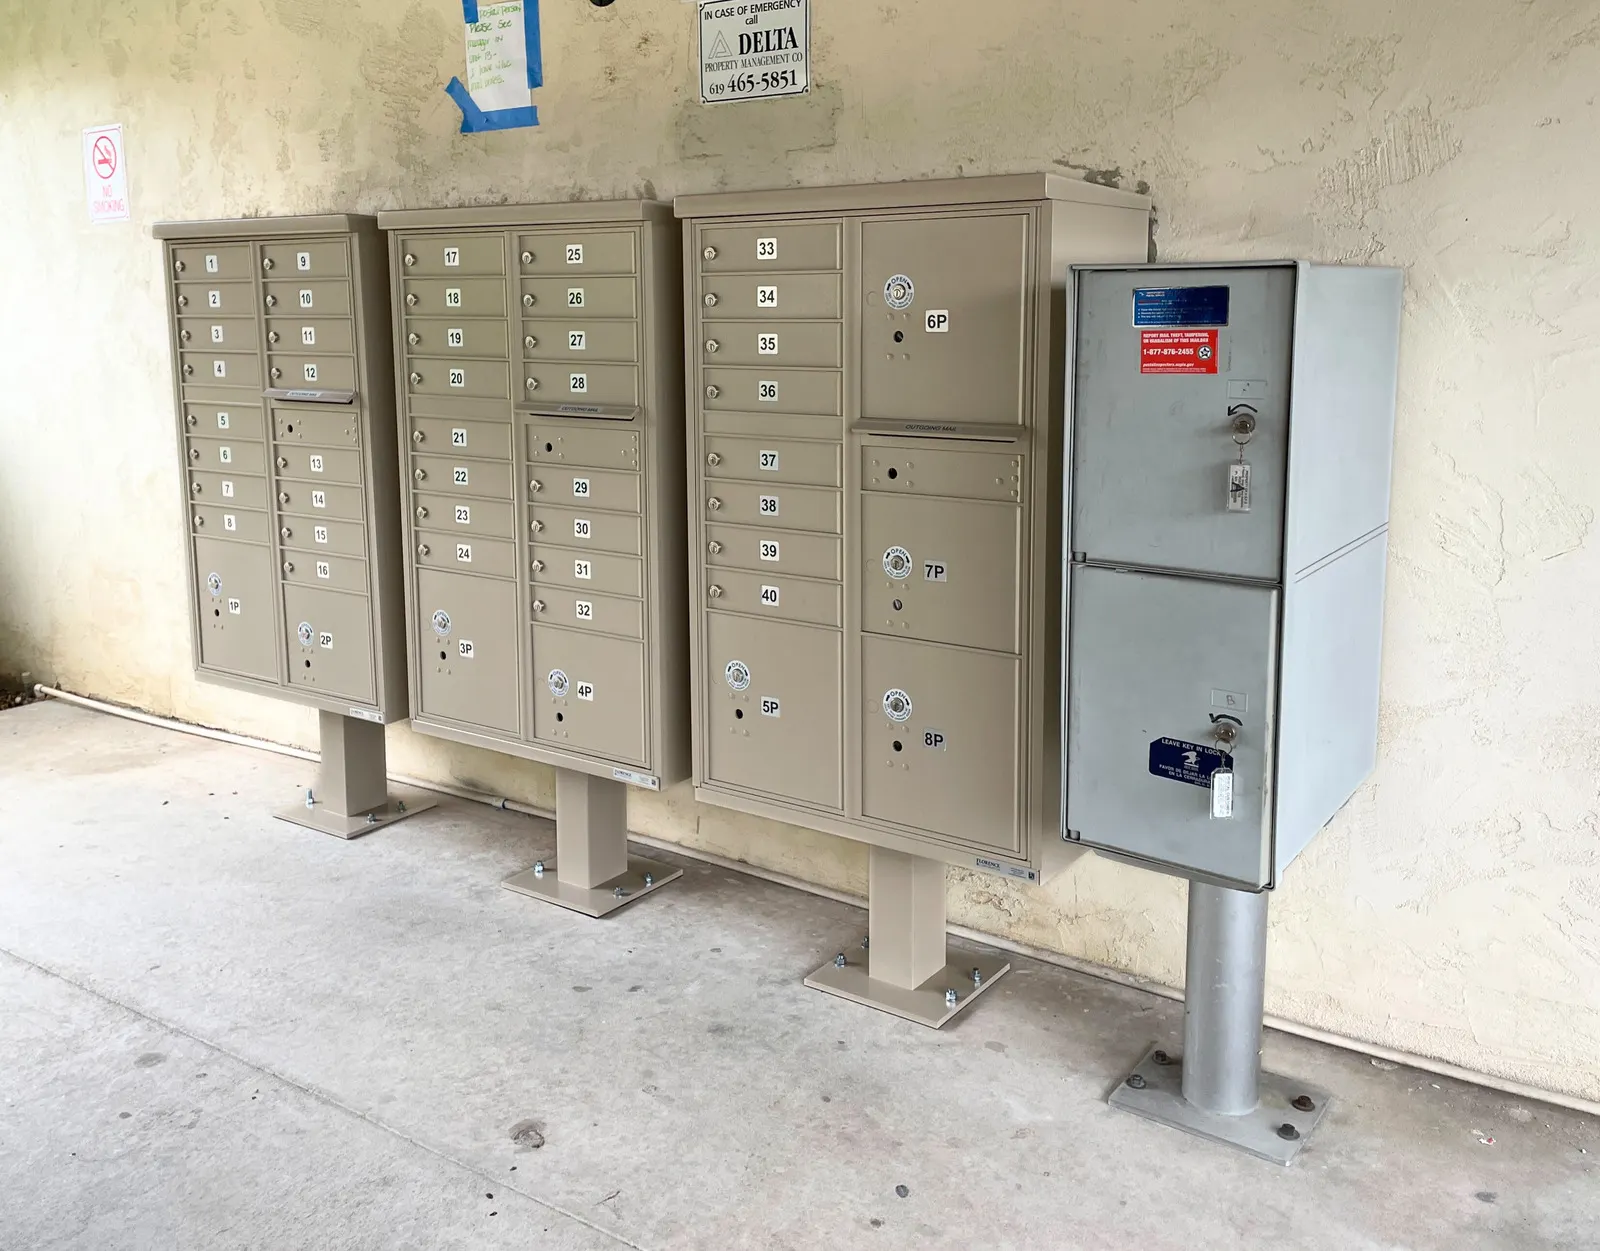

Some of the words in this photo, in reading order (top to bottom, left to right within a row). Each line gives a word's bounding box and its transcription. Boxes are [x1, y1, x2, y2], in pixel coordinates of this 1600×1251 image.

[704, 11, 712, 20] IN
[715, 8, 734, 18] CASE
[737, 5, 748, 15] OF
[750, 0, 801, 13] EMERGENCY
[745, 15, 758, 25] call
[738, 26, 798, 55] DELTA
[704, 60, 739, 72] PROPERTY
[741, 54, 790, 68] MANAGEMENT
[792, 52, 802, 62] CO
[709, 83, 725, 95] 619
[728, 69, 798, 93] 465-5851
[102, 184, 112, 198] NO
[93, 198, 124, 213] SMOKING
[760, 242, 774, 255] 33
[446, 252, 457, 262] 17
[568, 249, 580, 260] 25
[209, 259, 214, 268] 1
[300, 256, 306, 266] 9
[212, 294, 217, 304] 2
[302, 294, 311, 304] 10
[448, 293, 459, 304] 18
[569, 292, 582, 304] 26
[760, 290, 774, 303] 34
[928, 315, 947, 328] 6P
[214, 329, 219, 339] 3
[304, 331, 313, 341] 11
[450, 333, 461, 344] 19
[571, 335, 583, 346] 27
[761, 338, 775, 350] 35
[217, 364, 222, 374] 4
[306, 367, 315, 378] 12
[451, 373, 462, 384] 20
[572, 377, 584, 389] 28
[761, 385, 775, 398] 36
[221, 416, 226, 425] 5
[454, 432, 464, 443] 21
[223, 450, 228, 459] 6
[762, 454, 776, 466] 37
[312, 458, 322, 469] 13
[455, 471, 466, 482] 22
[225, 484, 230, 494] 7
[575, 482, 587, 493] 29
[1230, 482, 1244, 492] A
[314, 494, 324, 505] 14
[762, 499, 776, 512] 38
[457, 510, 468, 521] 23
[227, 518, 233, 528] 8
[576, 523, 588, 534] 30
[316, 530, 326, 540] 15
[459, 548, 469, 558] 24
[763, 544, 776, 557] 39
[890, 548, 907, 557] OPEN
[318, 565, 328, 576] 16
[577, 564, 588, 575] 31
[925, 564, 944, 578] 7P
[762, 589, 777, 602] 40
[230, 601, 239, 611] 1P
[578, 604, 590, 616] 32
[321, 635, 331, 645] 2P
[461, 643, 472, 654] 3P
[579, 686, 592, 697] 4P
[890, 690, 906, 699] OPEN
[763, 701, 778, 714] 5P
[925, 732, 943, 747] 8P
[1162, 739, 1180, 747] LEAVE
[1205, 748, 1222, 756] LOCK
